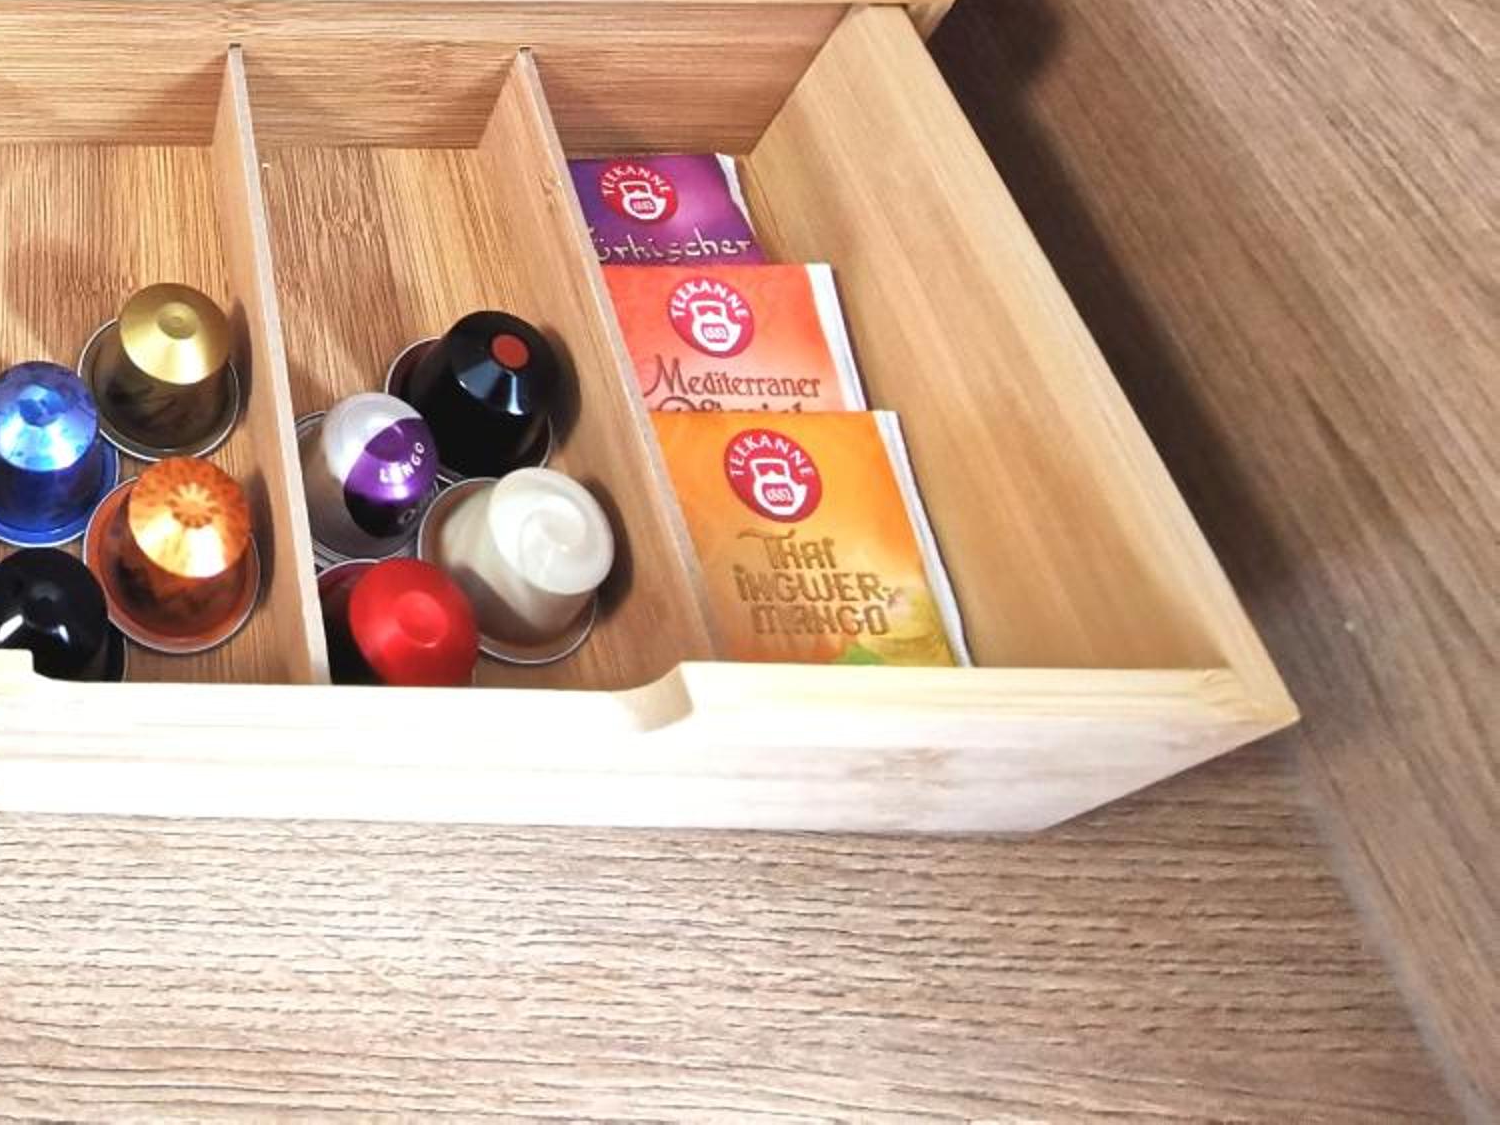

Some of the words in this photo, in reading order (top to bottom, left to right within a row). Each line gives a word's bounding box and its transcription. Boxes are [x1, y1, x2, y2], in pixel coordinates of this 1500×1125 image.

[602, 165, 672, 197] TEEKANNE
[587, 225, 751, 263] ürkischer
[670, 279, 749, 319] TEEKANNE
[643, 353, 821, 398] Mediterraner
[729, 434, 815, 477] TEEKANNE
